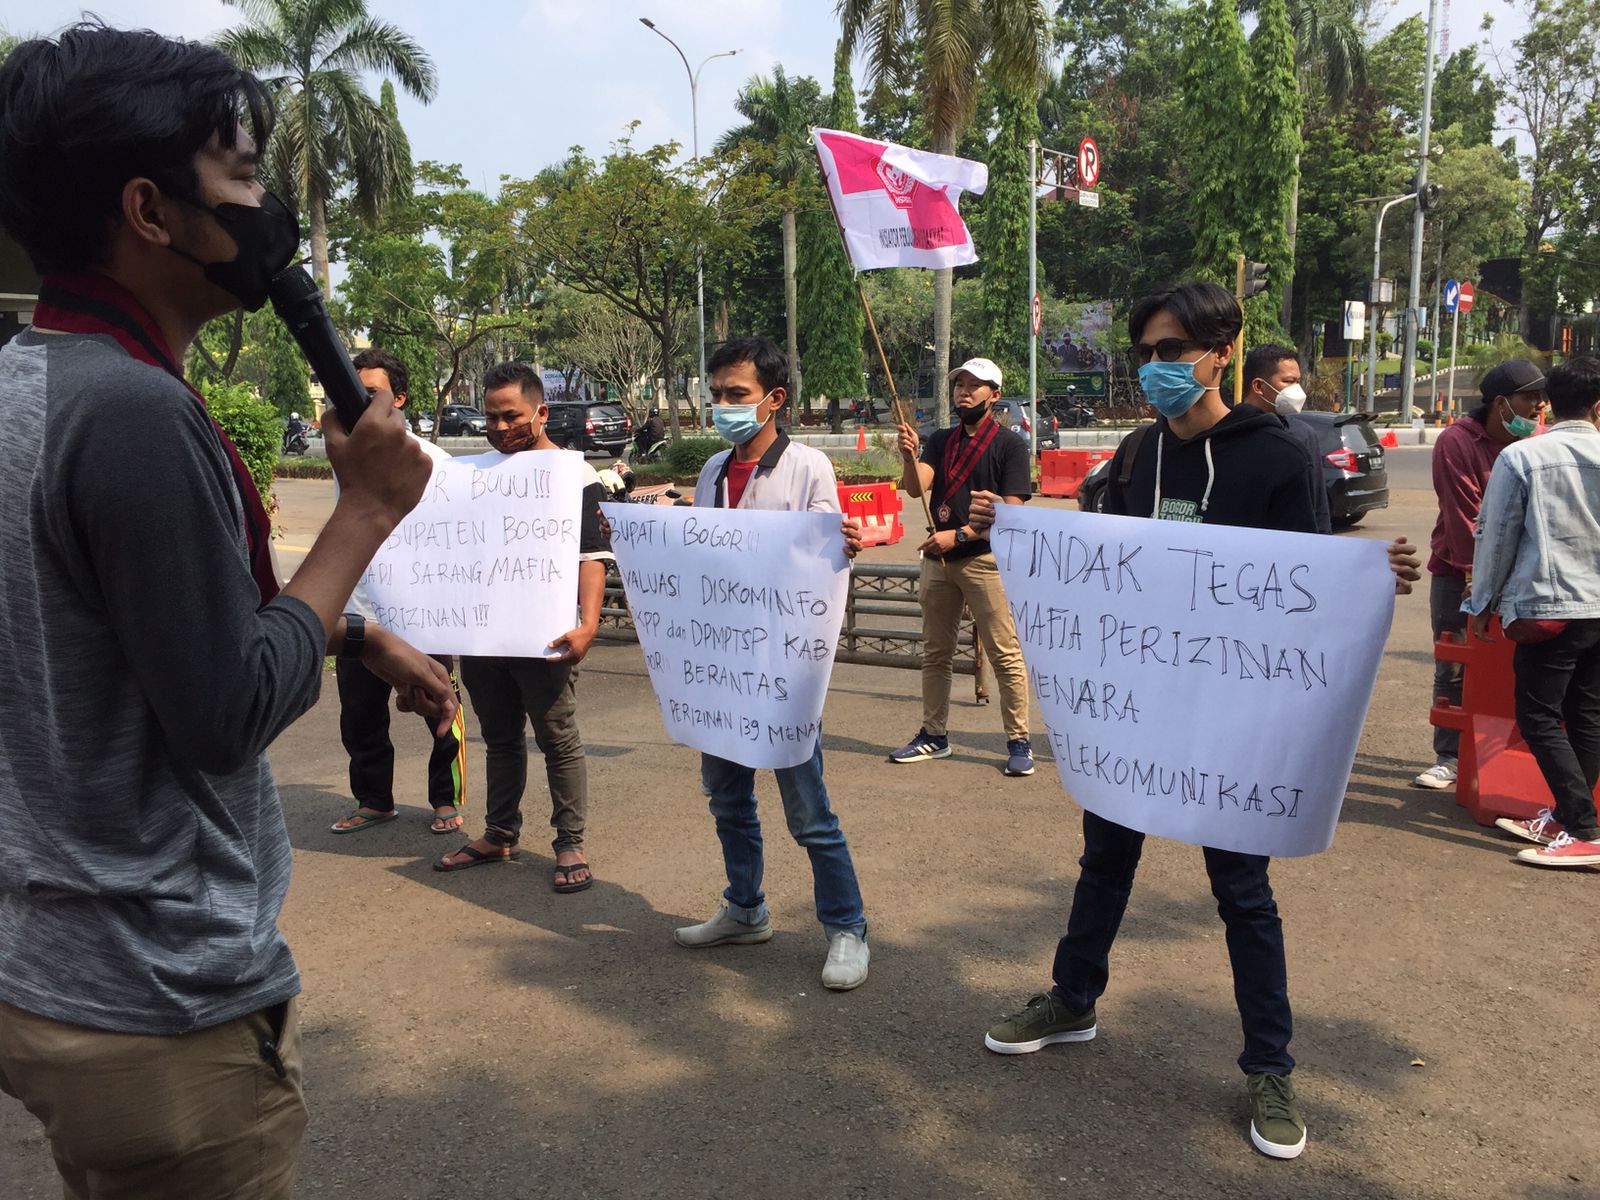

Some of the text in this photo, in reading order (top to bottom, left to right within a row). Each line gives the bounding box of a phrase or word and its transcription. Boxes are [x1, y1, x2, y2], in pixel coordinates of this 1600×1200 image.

[503, 515, 578, 546] BOGOR
[410, 560, 483, 585] SARANG
[487, 556, 563, 587] MAFIA
[997, 527, 1317, 614] TINDAK TEGAS
[691, 619, 769, 656] DPMPTSP
[783, 631, 830, 661] KAB
[1010, 600, 1328, 690] MAFIA PERIZINAN
[684, 659, 789, 701] BERANTAS
[669, 698, 733, 730] PERIZINAN
[739, 717, 760, 741] 139
